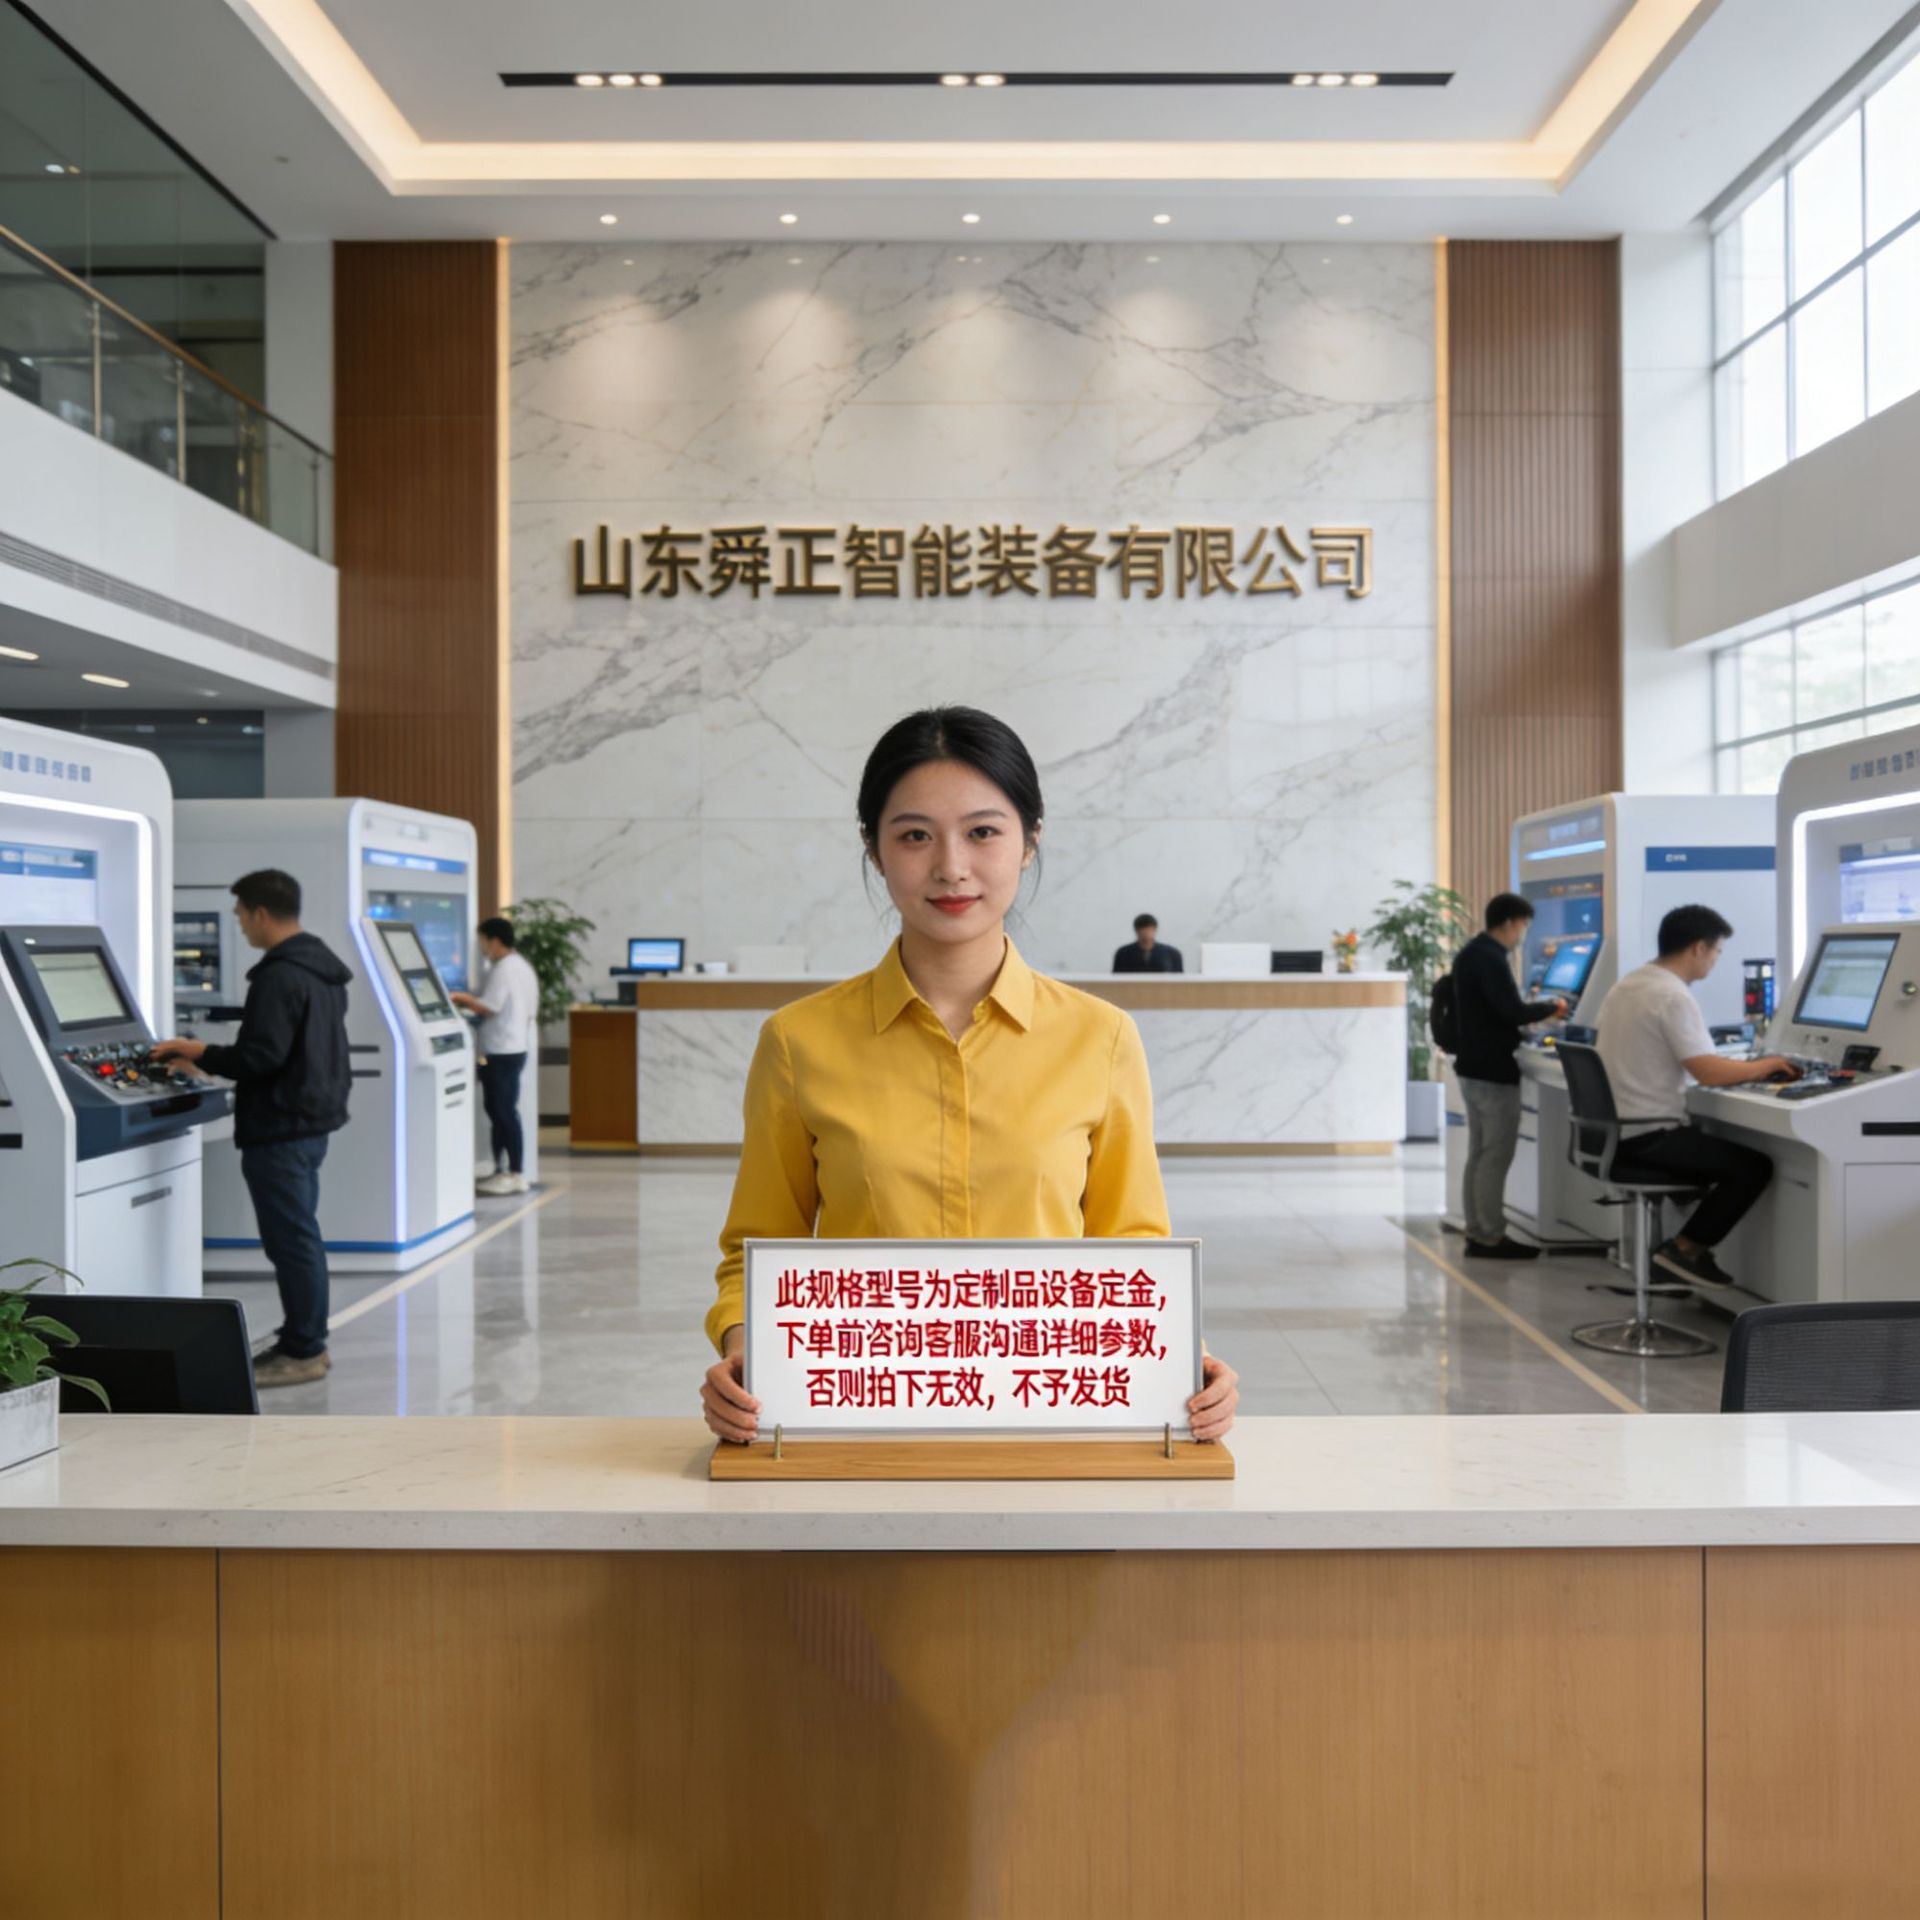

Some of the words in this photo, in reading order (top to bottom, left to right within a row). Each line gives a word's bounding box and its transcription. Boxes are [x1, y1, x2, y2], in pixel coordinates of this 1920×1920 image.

[572, 524, 1375, 600] 山东舜正智能装备有限公司
